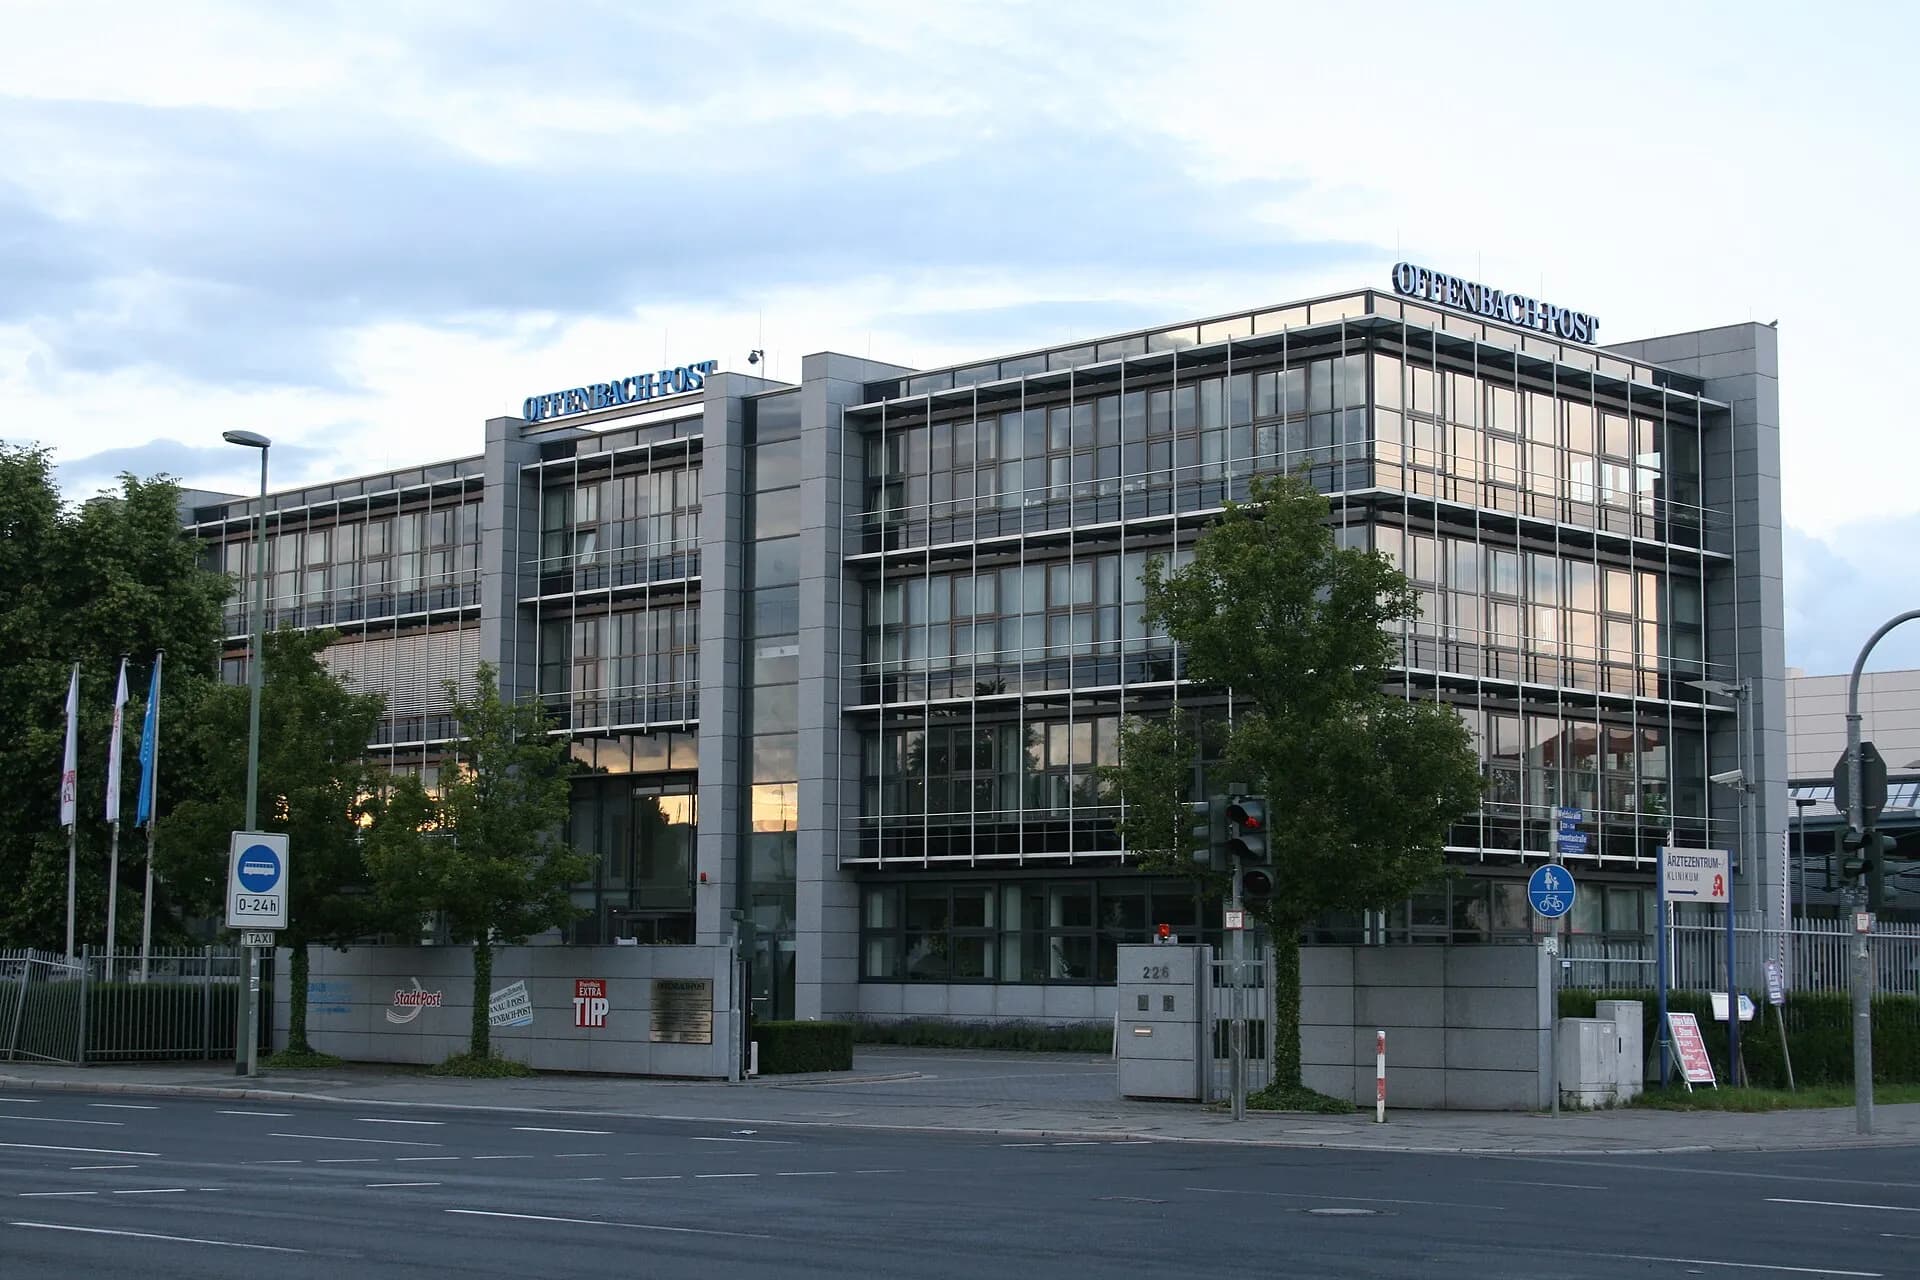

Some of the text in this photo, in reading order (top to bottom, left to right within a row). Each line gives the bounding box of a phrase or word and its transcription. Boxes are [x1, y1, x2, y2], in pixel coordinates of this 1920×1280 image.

[1392, 262, 1600, 345] OFFENBACH-POST
[523, 359, 718, 423] OFFENBACH-POST
[1667, 871, 1699, 882] KLINIKUM
[248, 933, 272, 944] TAXI
[1143, 966, 1169, 979] 226
[579, 987, 602, 996] EXTRA
[511, 995, 525, 1007] POST
[573, 997, 609, 1026] TIPP
